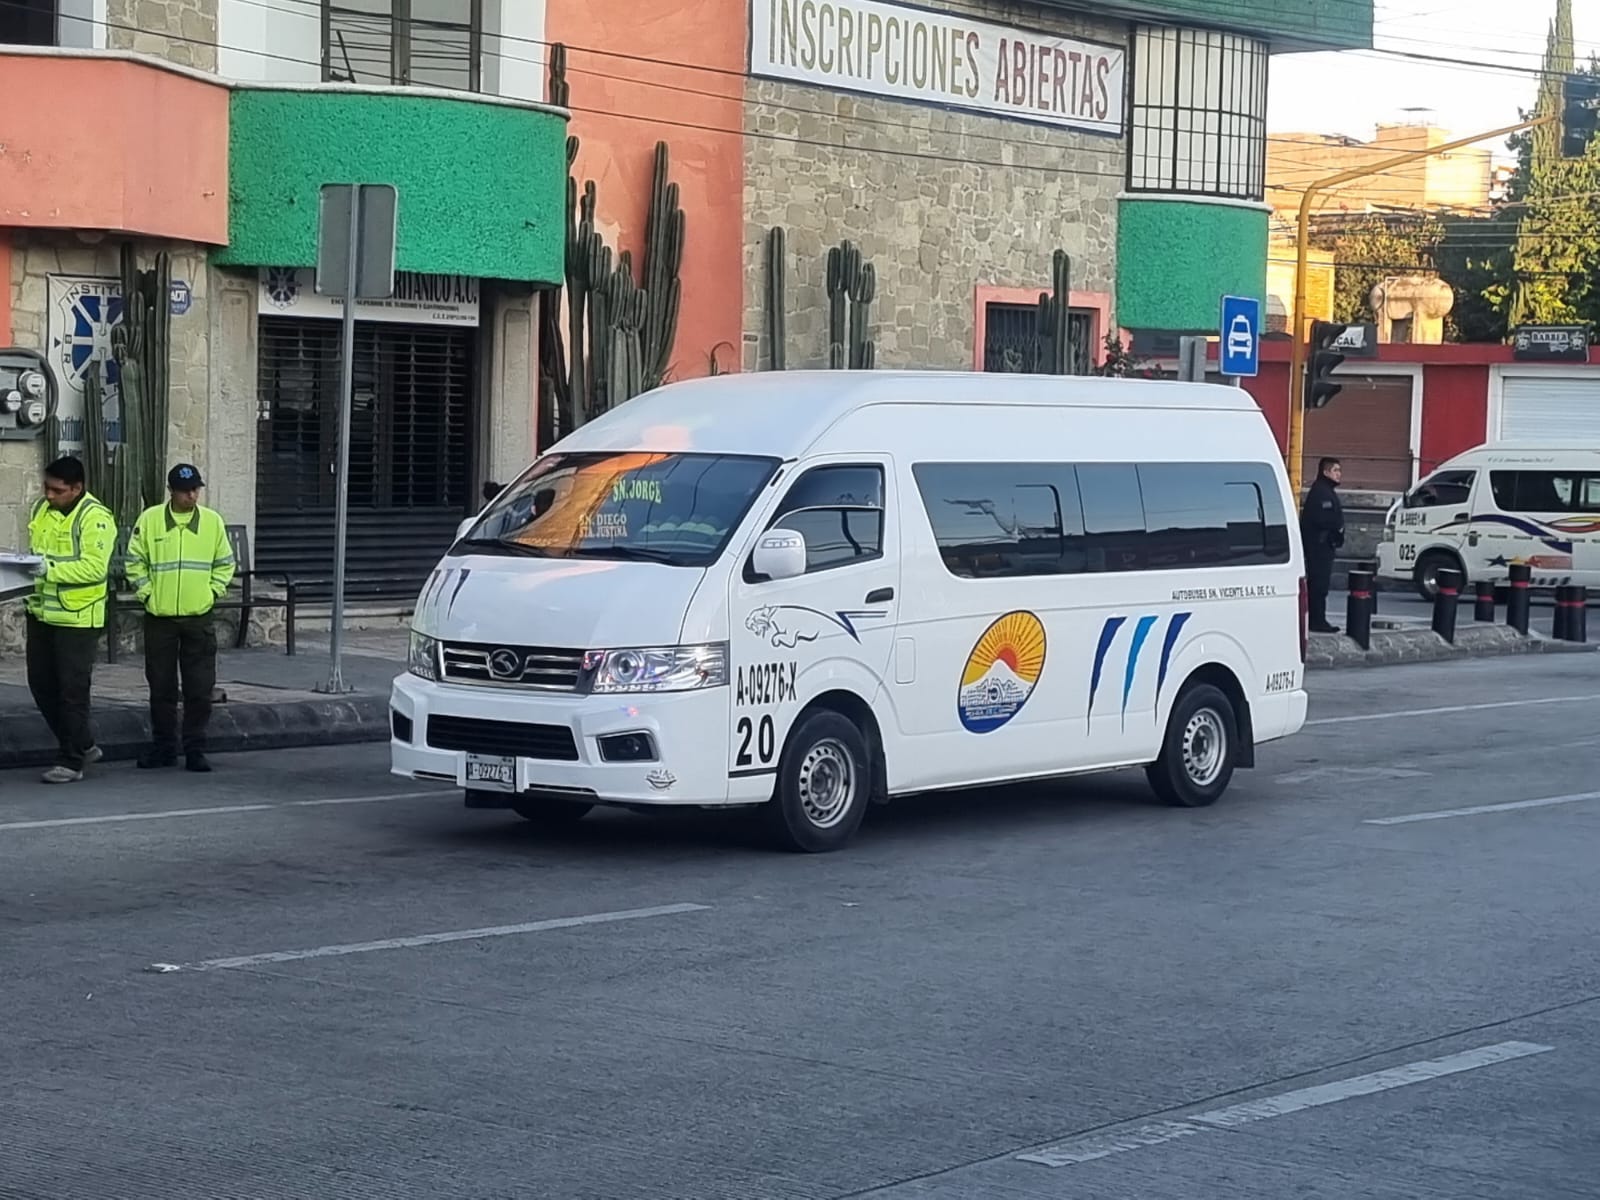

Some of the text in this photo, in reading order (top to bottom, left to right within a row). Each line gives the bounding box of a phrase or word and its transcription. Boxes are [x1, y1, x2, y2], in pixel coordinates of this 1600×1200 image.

[769, 0, 1109, 121] INSCRIPCIONES ABIERTAS
[629, 479, 662, 504] JORGE
[597, 513, 627, 526] DIEGO
[1399, 543, 1417, 561] 025
[1219, 587, 1244, 598] VICENTE
[1257, 585, 1265, 596] DE
[736, 661, 797, 707] A-09276-X
[736, 714, 775, 767] 20
